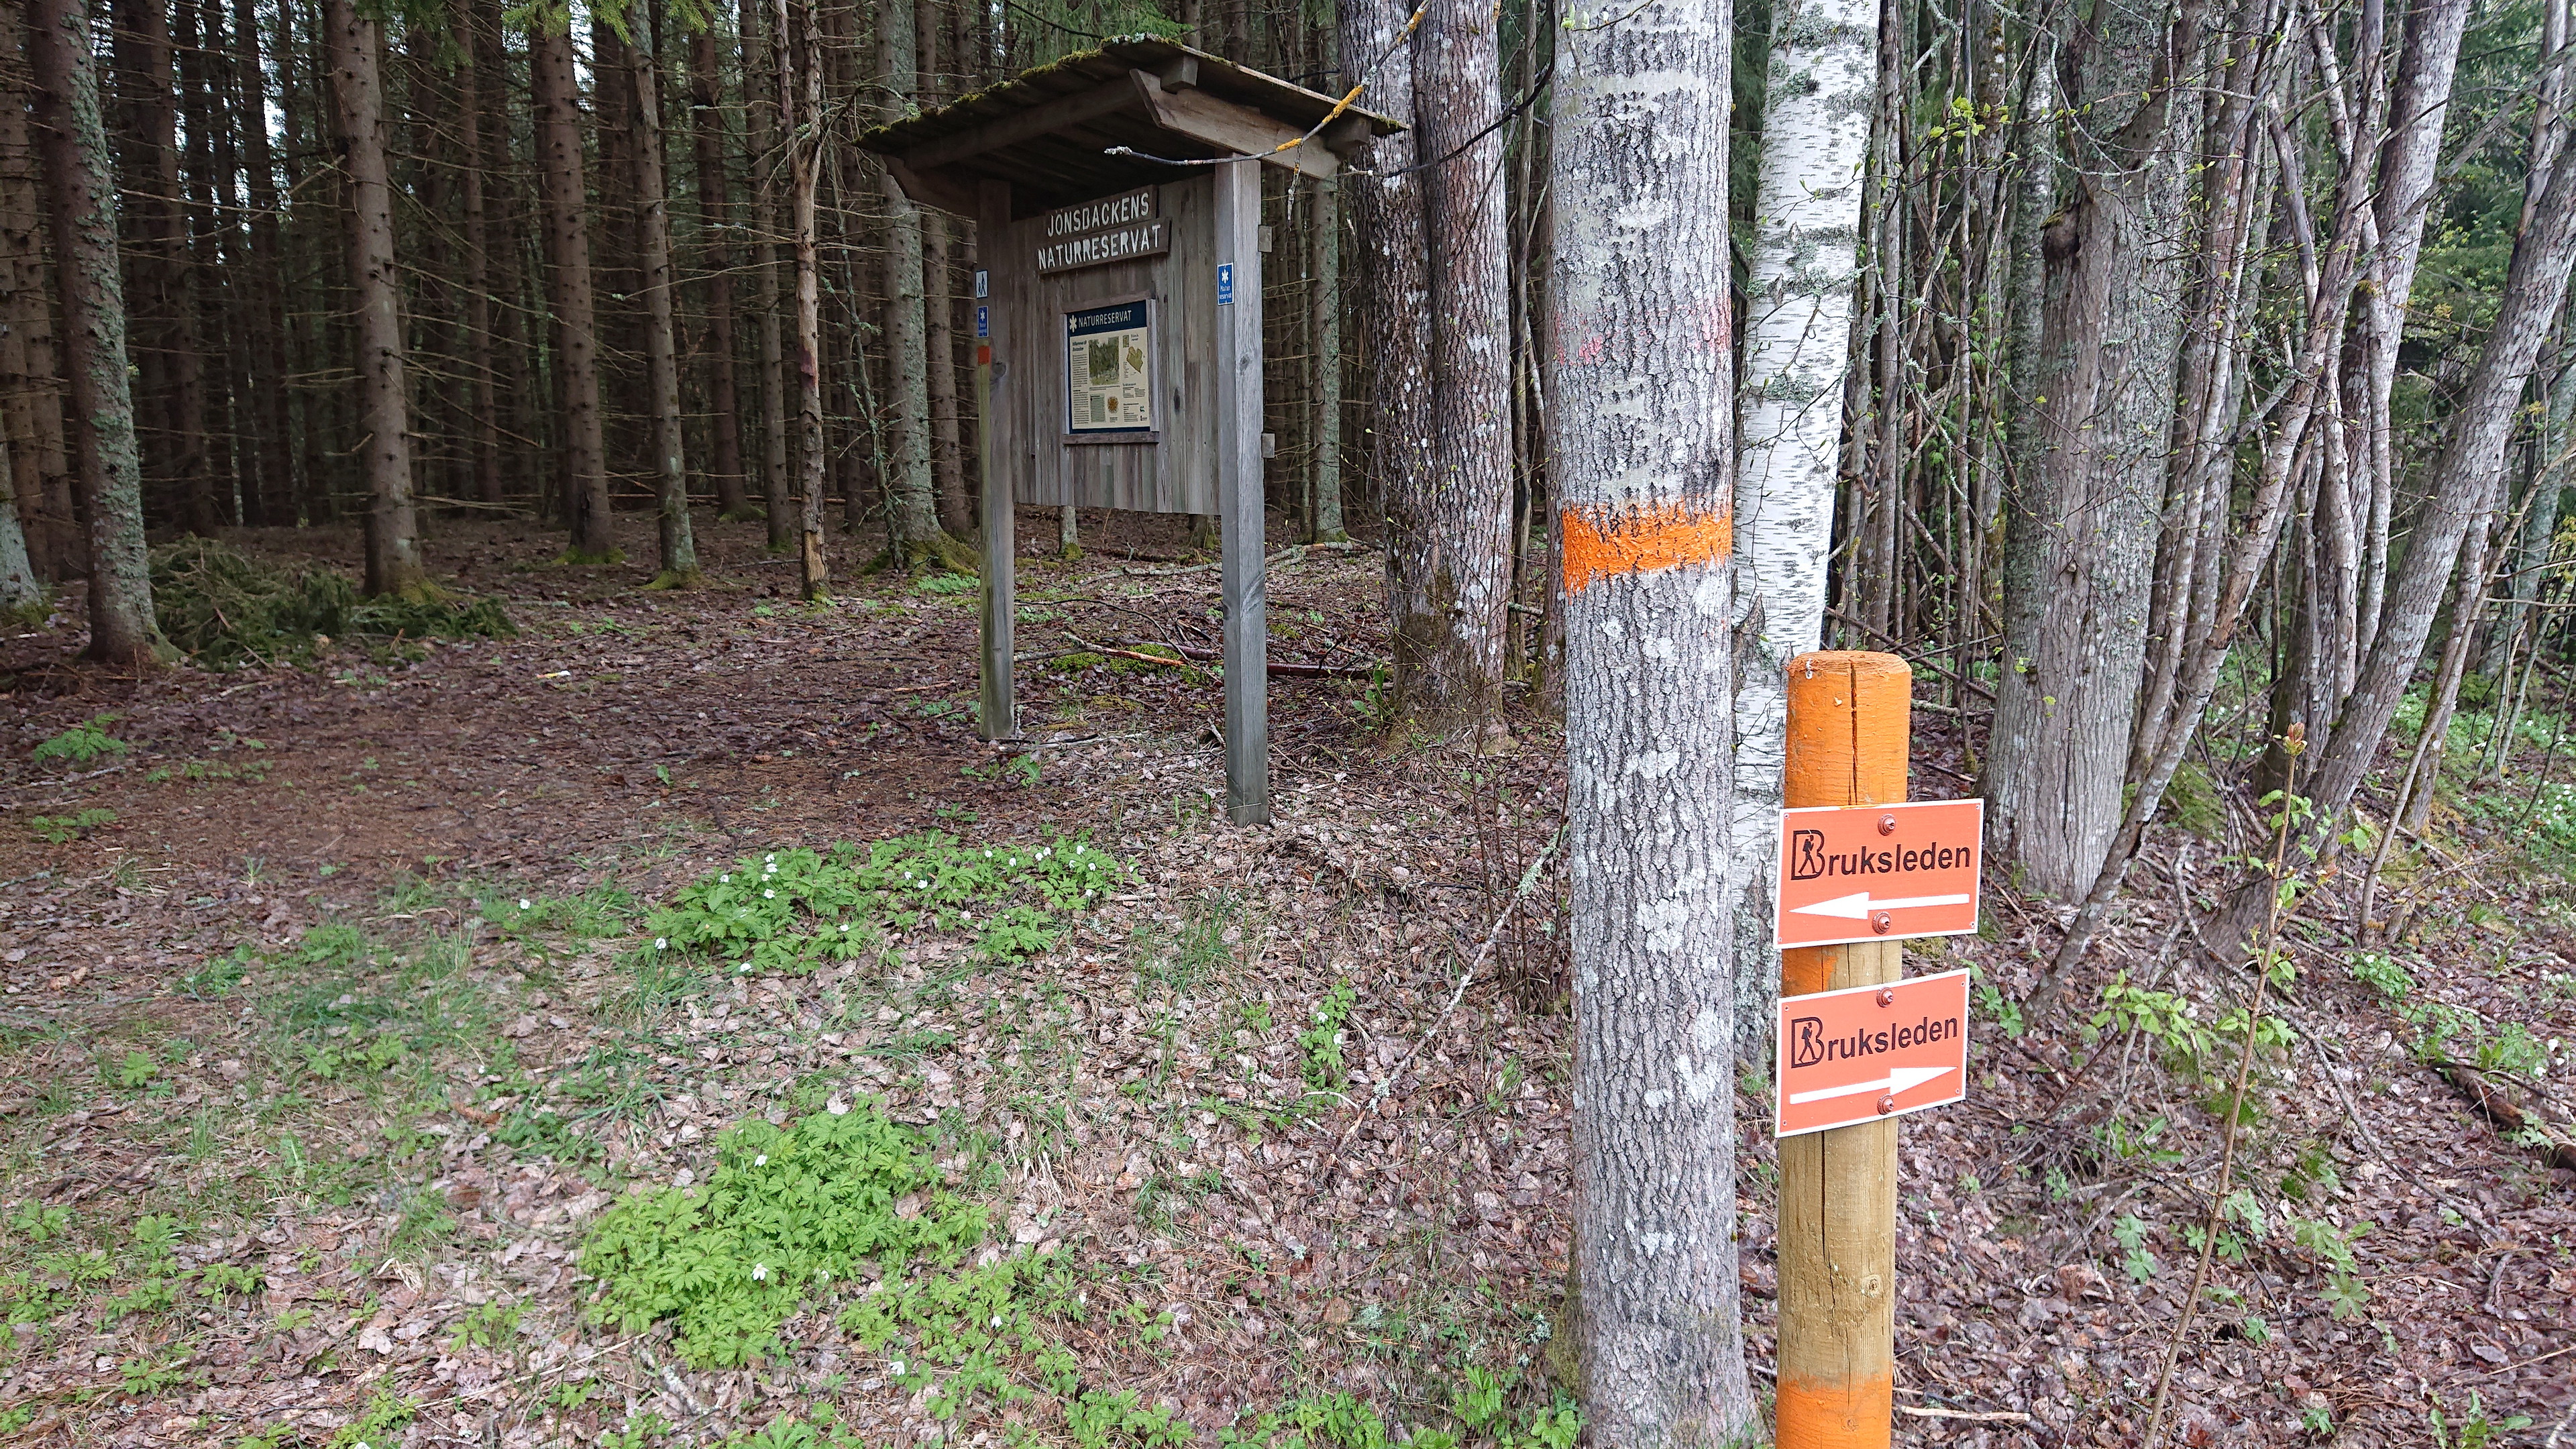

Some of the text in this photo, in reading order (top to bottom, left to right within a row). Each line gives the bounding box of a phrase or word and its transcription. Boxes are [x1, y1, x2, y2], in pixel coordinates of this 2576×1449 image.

[1038, 223, 1160, 270] NATURRESERVAT
[1079, 310, 1132, 328] NATURRESERVAT
[1791, 829, 1970, 880] Bruksleden
[1791, 1016, 1957, 1069] Bruksleden
